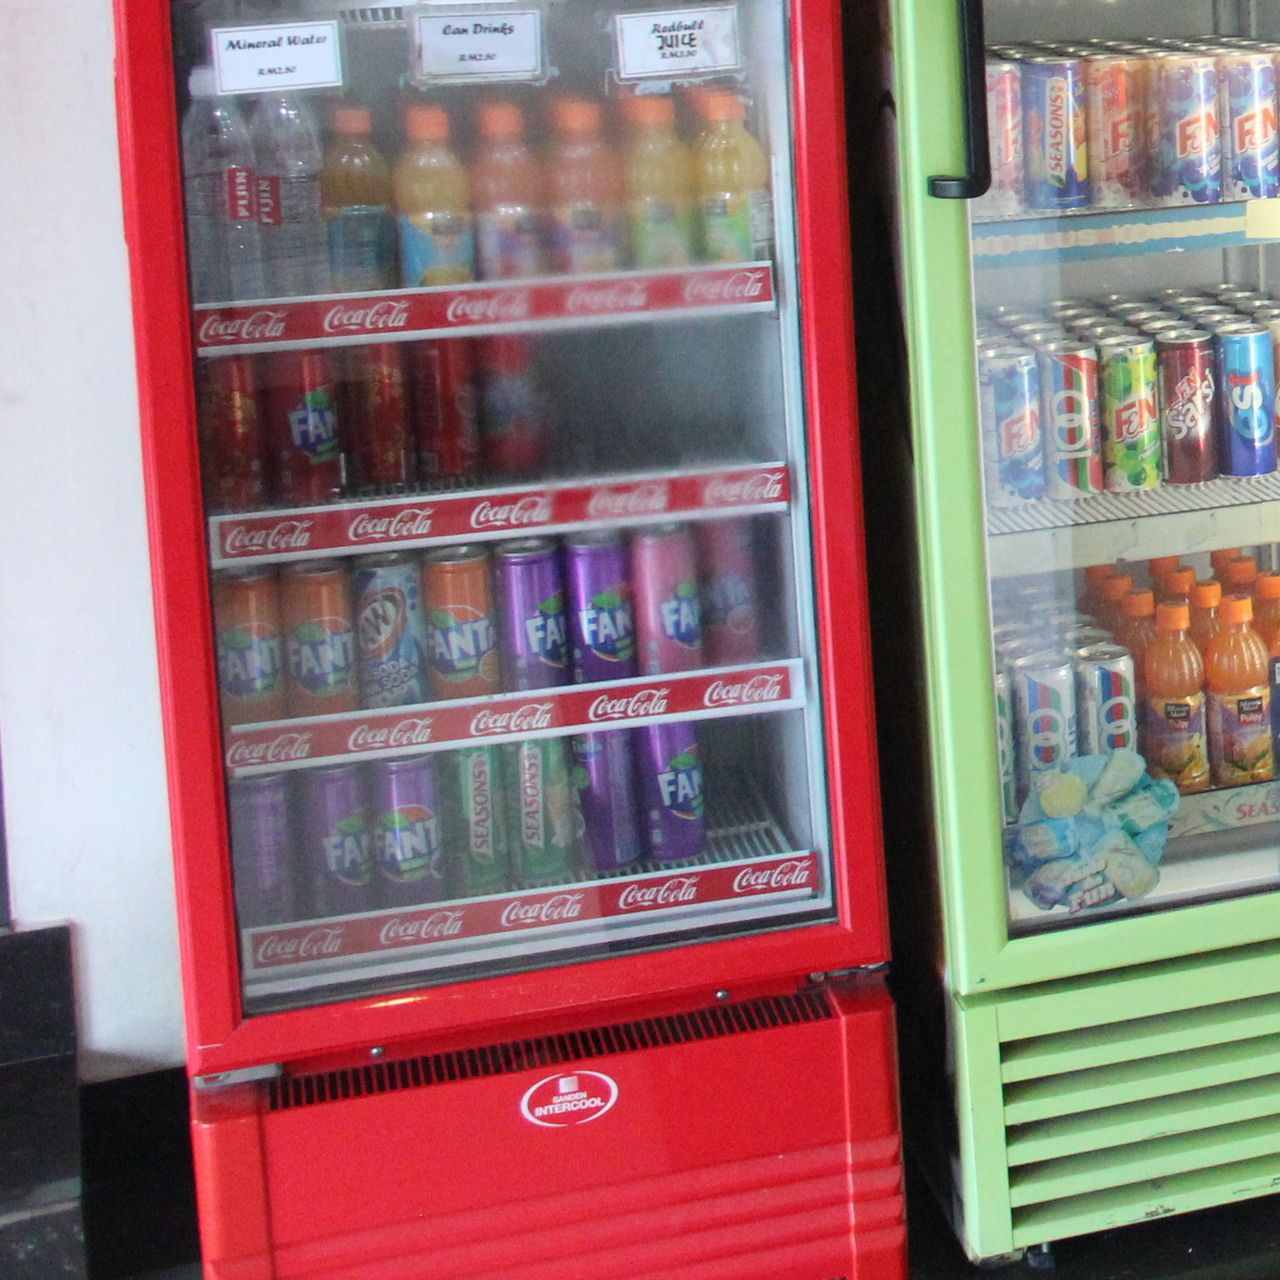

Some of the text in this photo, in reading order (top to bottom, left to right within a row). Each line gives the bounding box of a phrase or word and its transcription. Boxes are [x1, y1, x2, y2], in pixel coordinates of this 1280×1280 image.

[226, 34, 327, 52] Mineral Water
[443, 23, 514, 36] Can Drinks
[657, 32, 697, 50] JUICE
[324, 300, 410, 332] Coca-Cola
[225, 520, 313, 553] Coca-Cola
[349, 508, 435, 541] Coca-Cola
[588, 688, 670, 721] Coca-Cola
[703, 674, 784, 707] Coca-Cola
[348, 718, 434, 750] Coca-Cola
[470, 702, 554, 735] Coca-Cola
[618, 876, 700, 909] Coca-Cola
[733, 859, 812, 893] Coca-Cola
[501, 891, 585, 926] Coca-Cola
[380, 910, 464, 944] Coca-Cola
[257, 928, 344, 963] Coca-Cola
[534, 1097, 605, 1117] INTERCOOL
[552, 1092, 587, 1104] SANDEN
